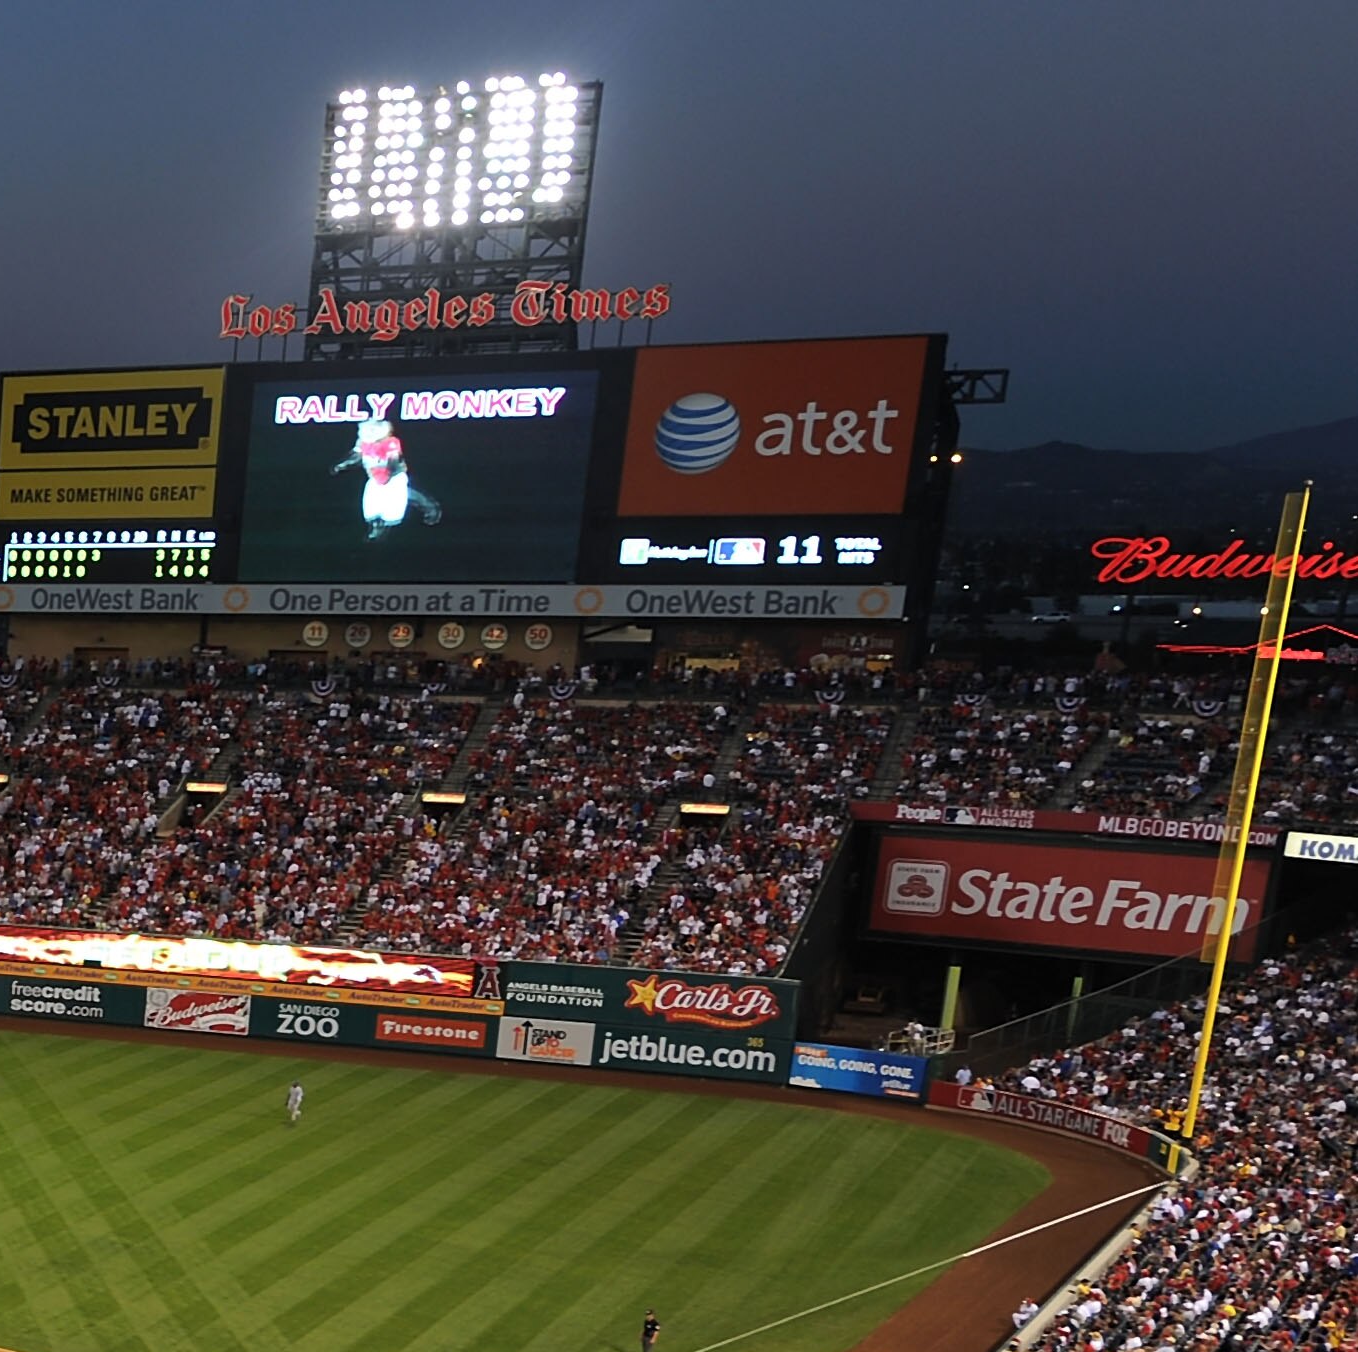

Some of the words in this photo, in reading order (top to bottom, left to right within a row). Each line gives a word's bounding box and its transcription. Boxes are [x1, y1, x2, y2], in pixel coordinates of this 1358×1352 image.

[219, 294, 297, 341] Los
[303, 287, 497, 342] Angeles
[510, 279, 672, 328] Times
[275, 393, 394, 423] RALLY
[400, 388, 566, 421] MONKEY
[28, 402, 198, 440] STANLEY
[754, 399, 899, 456] at&t
[10, 488, 52, 504] MAKE
[56, 486, 144, 503] SOMETHING
[777, 535, 822, 564] 11
[31, 588, 134, 611] OneWest
[141, 588, 199, 611] Bank
[270, 588, 322, 612] One
[328, 589, 412, 612] Person
[418, 590, 444, 613] at
[459, 596, 475, 613] a
[479, 589, 550, 613] Time
[626, 589, 756, 615] OneWest
[764, 590, 838, 616] Bank
[895, 804, 942, 822] People
[1300, 839, 1358, 861] KOM
[951, 868, 1089, 926] State
[1095, 879, 1250, 936] Farm
[11, 980, 101, 1002] freecredit
[506, 992, 604, 1008] FOUNDATION
[507, 981, 549, 993] ANGELS
[550, 983, 604, 996] BASEBALL
[654, 982, 733, 1011] Carl's
[732, 989, 778, 1017] Jr.
[10, 998, 104, 1018] score.com
[147, 994, 249, 1026] Budweiser
[278, 1002, 302, 1015] SAN
[305, 1004, 340, 1018] DIEGO
[276, 1013, 340, 1038] ZOO
[382, 1020, 480, 1041] Firestone
[531, 1028, 567, 1041] STAND
[530, 1046, 576, 1058] CANCER
[599, 1032, 777, 1073] jetblue.com
[1064, 1108, 1099, 1136] GAME
[1102, 1120, 1131, 1148] FOX
